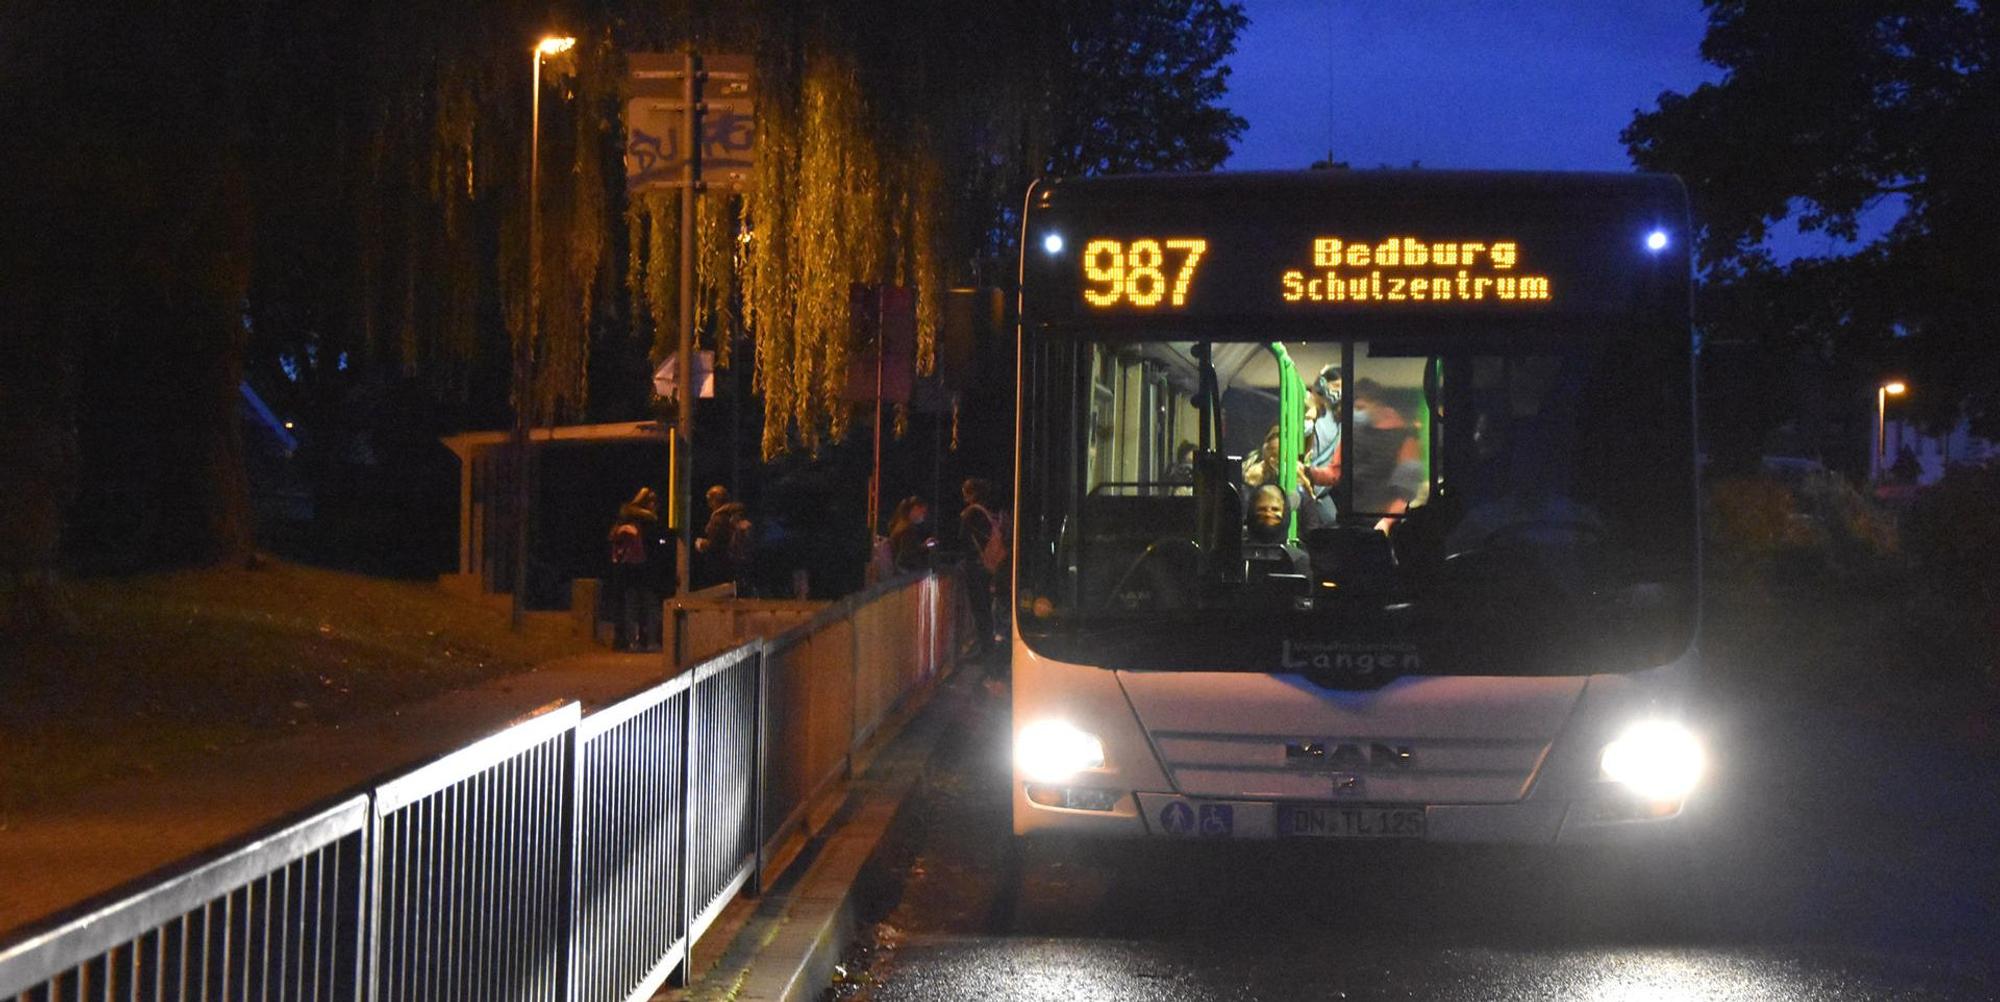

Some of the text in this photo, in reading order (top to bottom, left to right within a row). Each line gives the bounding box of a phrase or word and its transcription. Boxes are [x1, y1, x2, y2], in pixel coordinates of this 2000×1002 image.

[1313, 237, 1516, 269] Bedburg
[1084, 239, 1206, 306] 987
[1282, 270, 1549, 301] Schulzentrum
[1281, 639, 1421, 673] Langen
[1286, 743, 1411, 767] MAN
